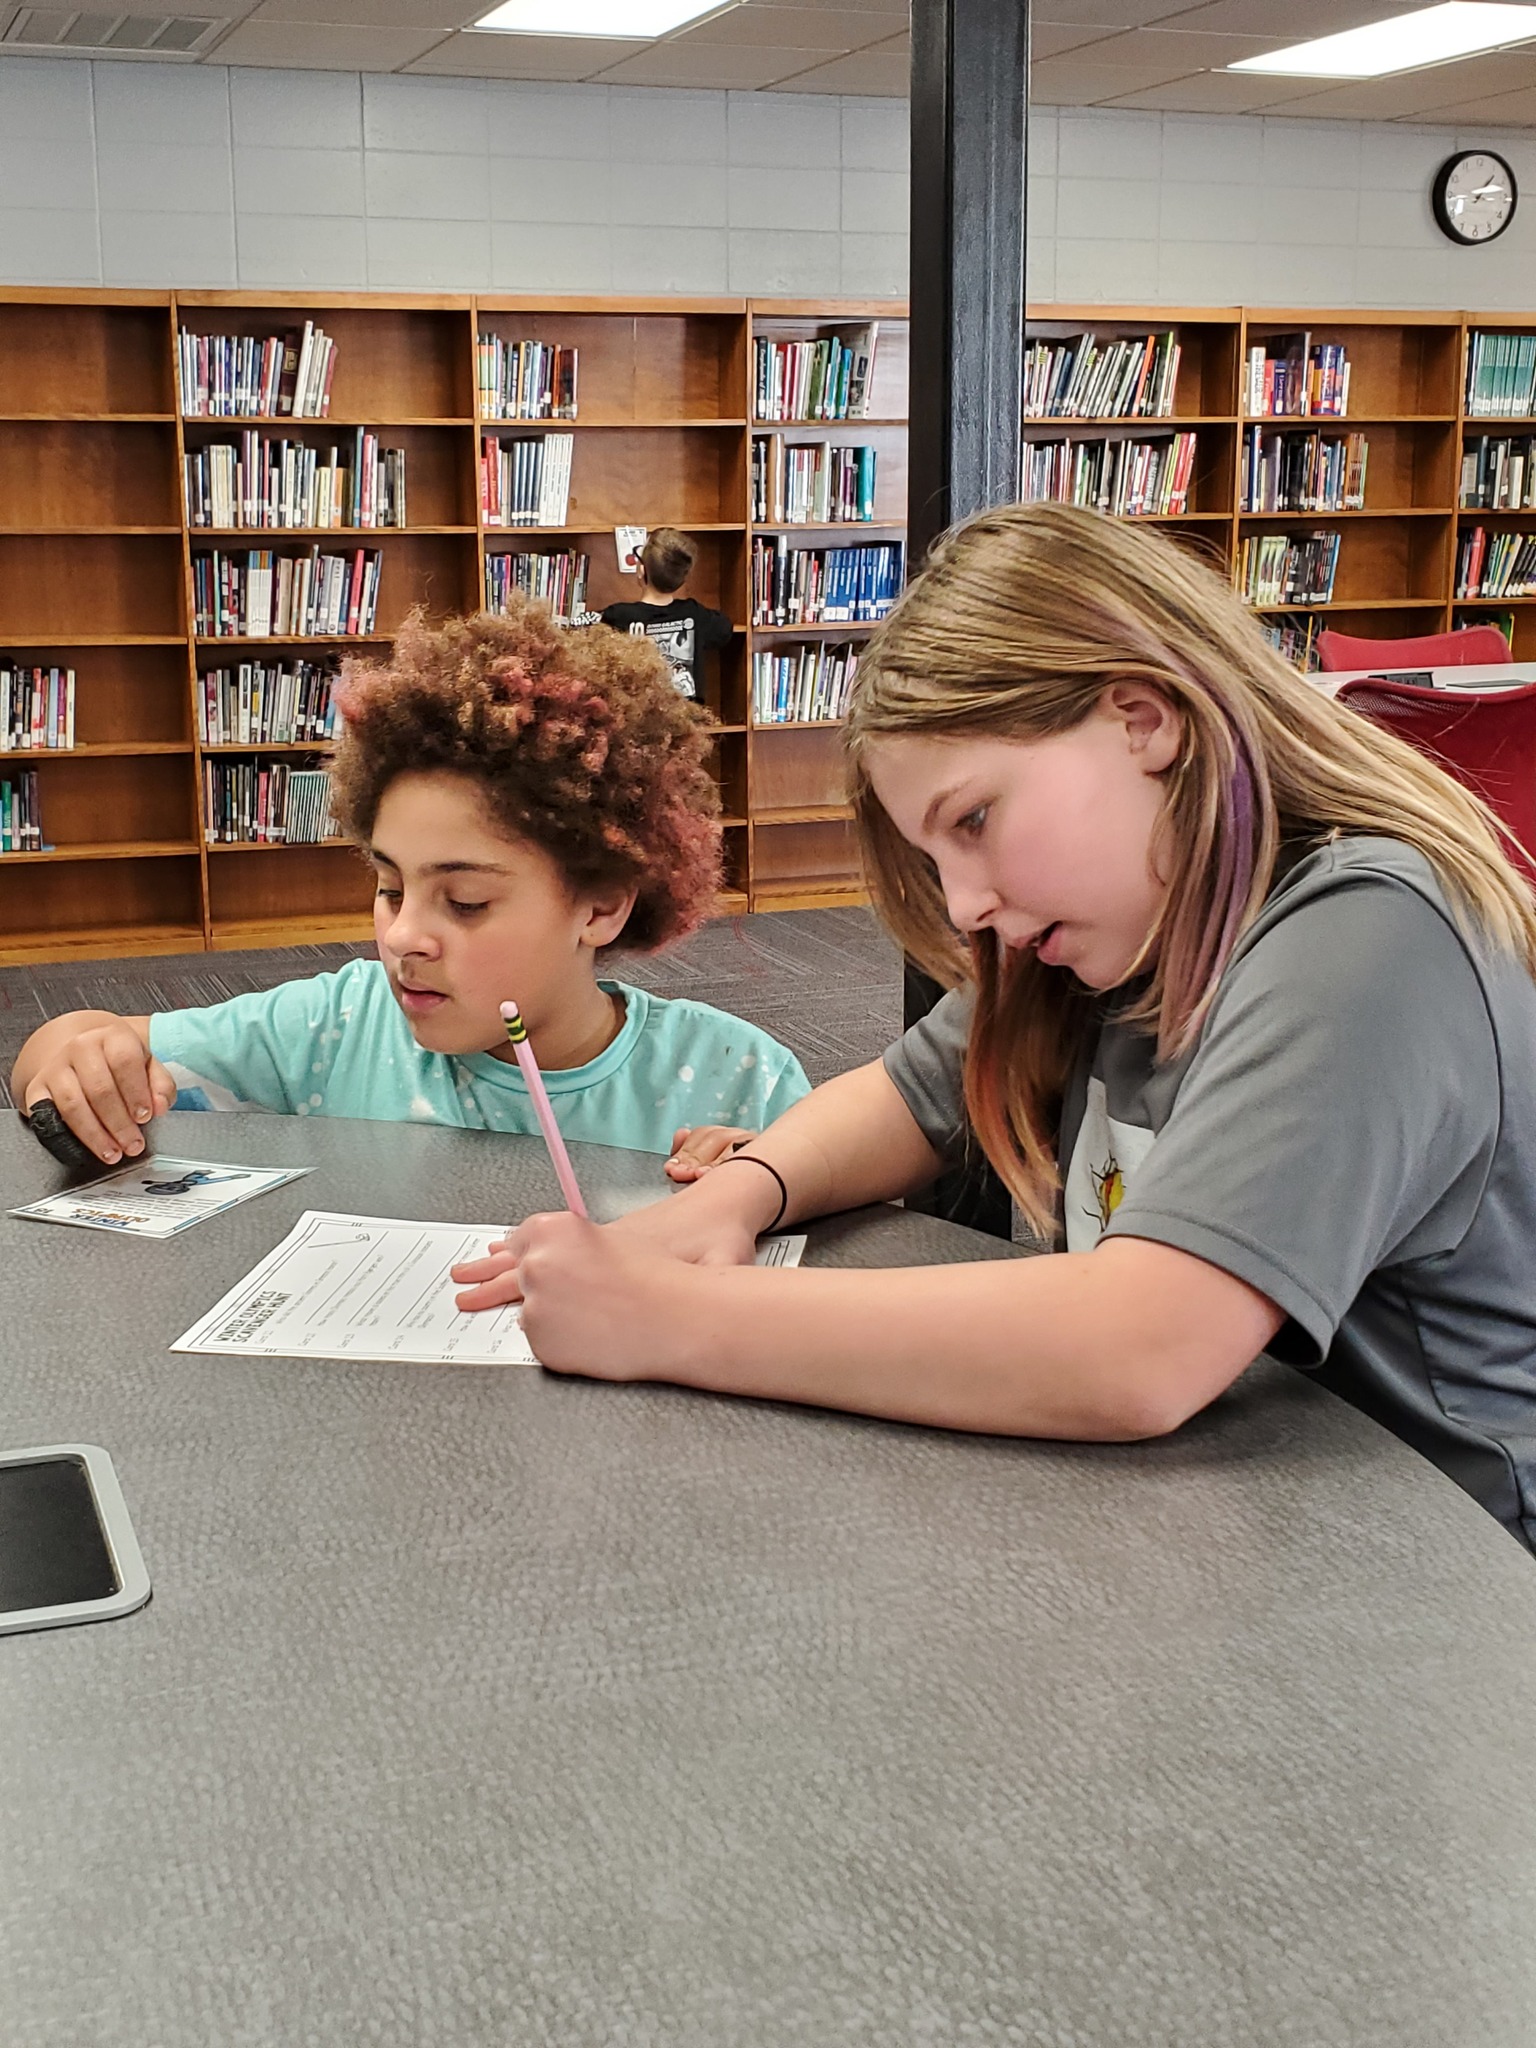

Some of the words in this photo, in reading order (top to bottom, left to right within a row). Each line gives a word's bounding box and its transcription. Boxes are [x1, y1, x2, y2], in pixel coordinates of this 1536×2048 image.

[1476, 158, 1484, 167] 12
[1472, 225, 1479, 237] 6
[1487, 222, 1492, 233] 5
[69, 1214, 131, 1227] WINTER
[71, 1208, 150, 1223] OLYMPICS
[213, 1319, 248, 1342] WINTER
[239, 1290, 277, 1319] OLYMPICS
[231, 1308, 278, 1343] SCAVENGER
[266, 1291, 293, 1308] HUNT
